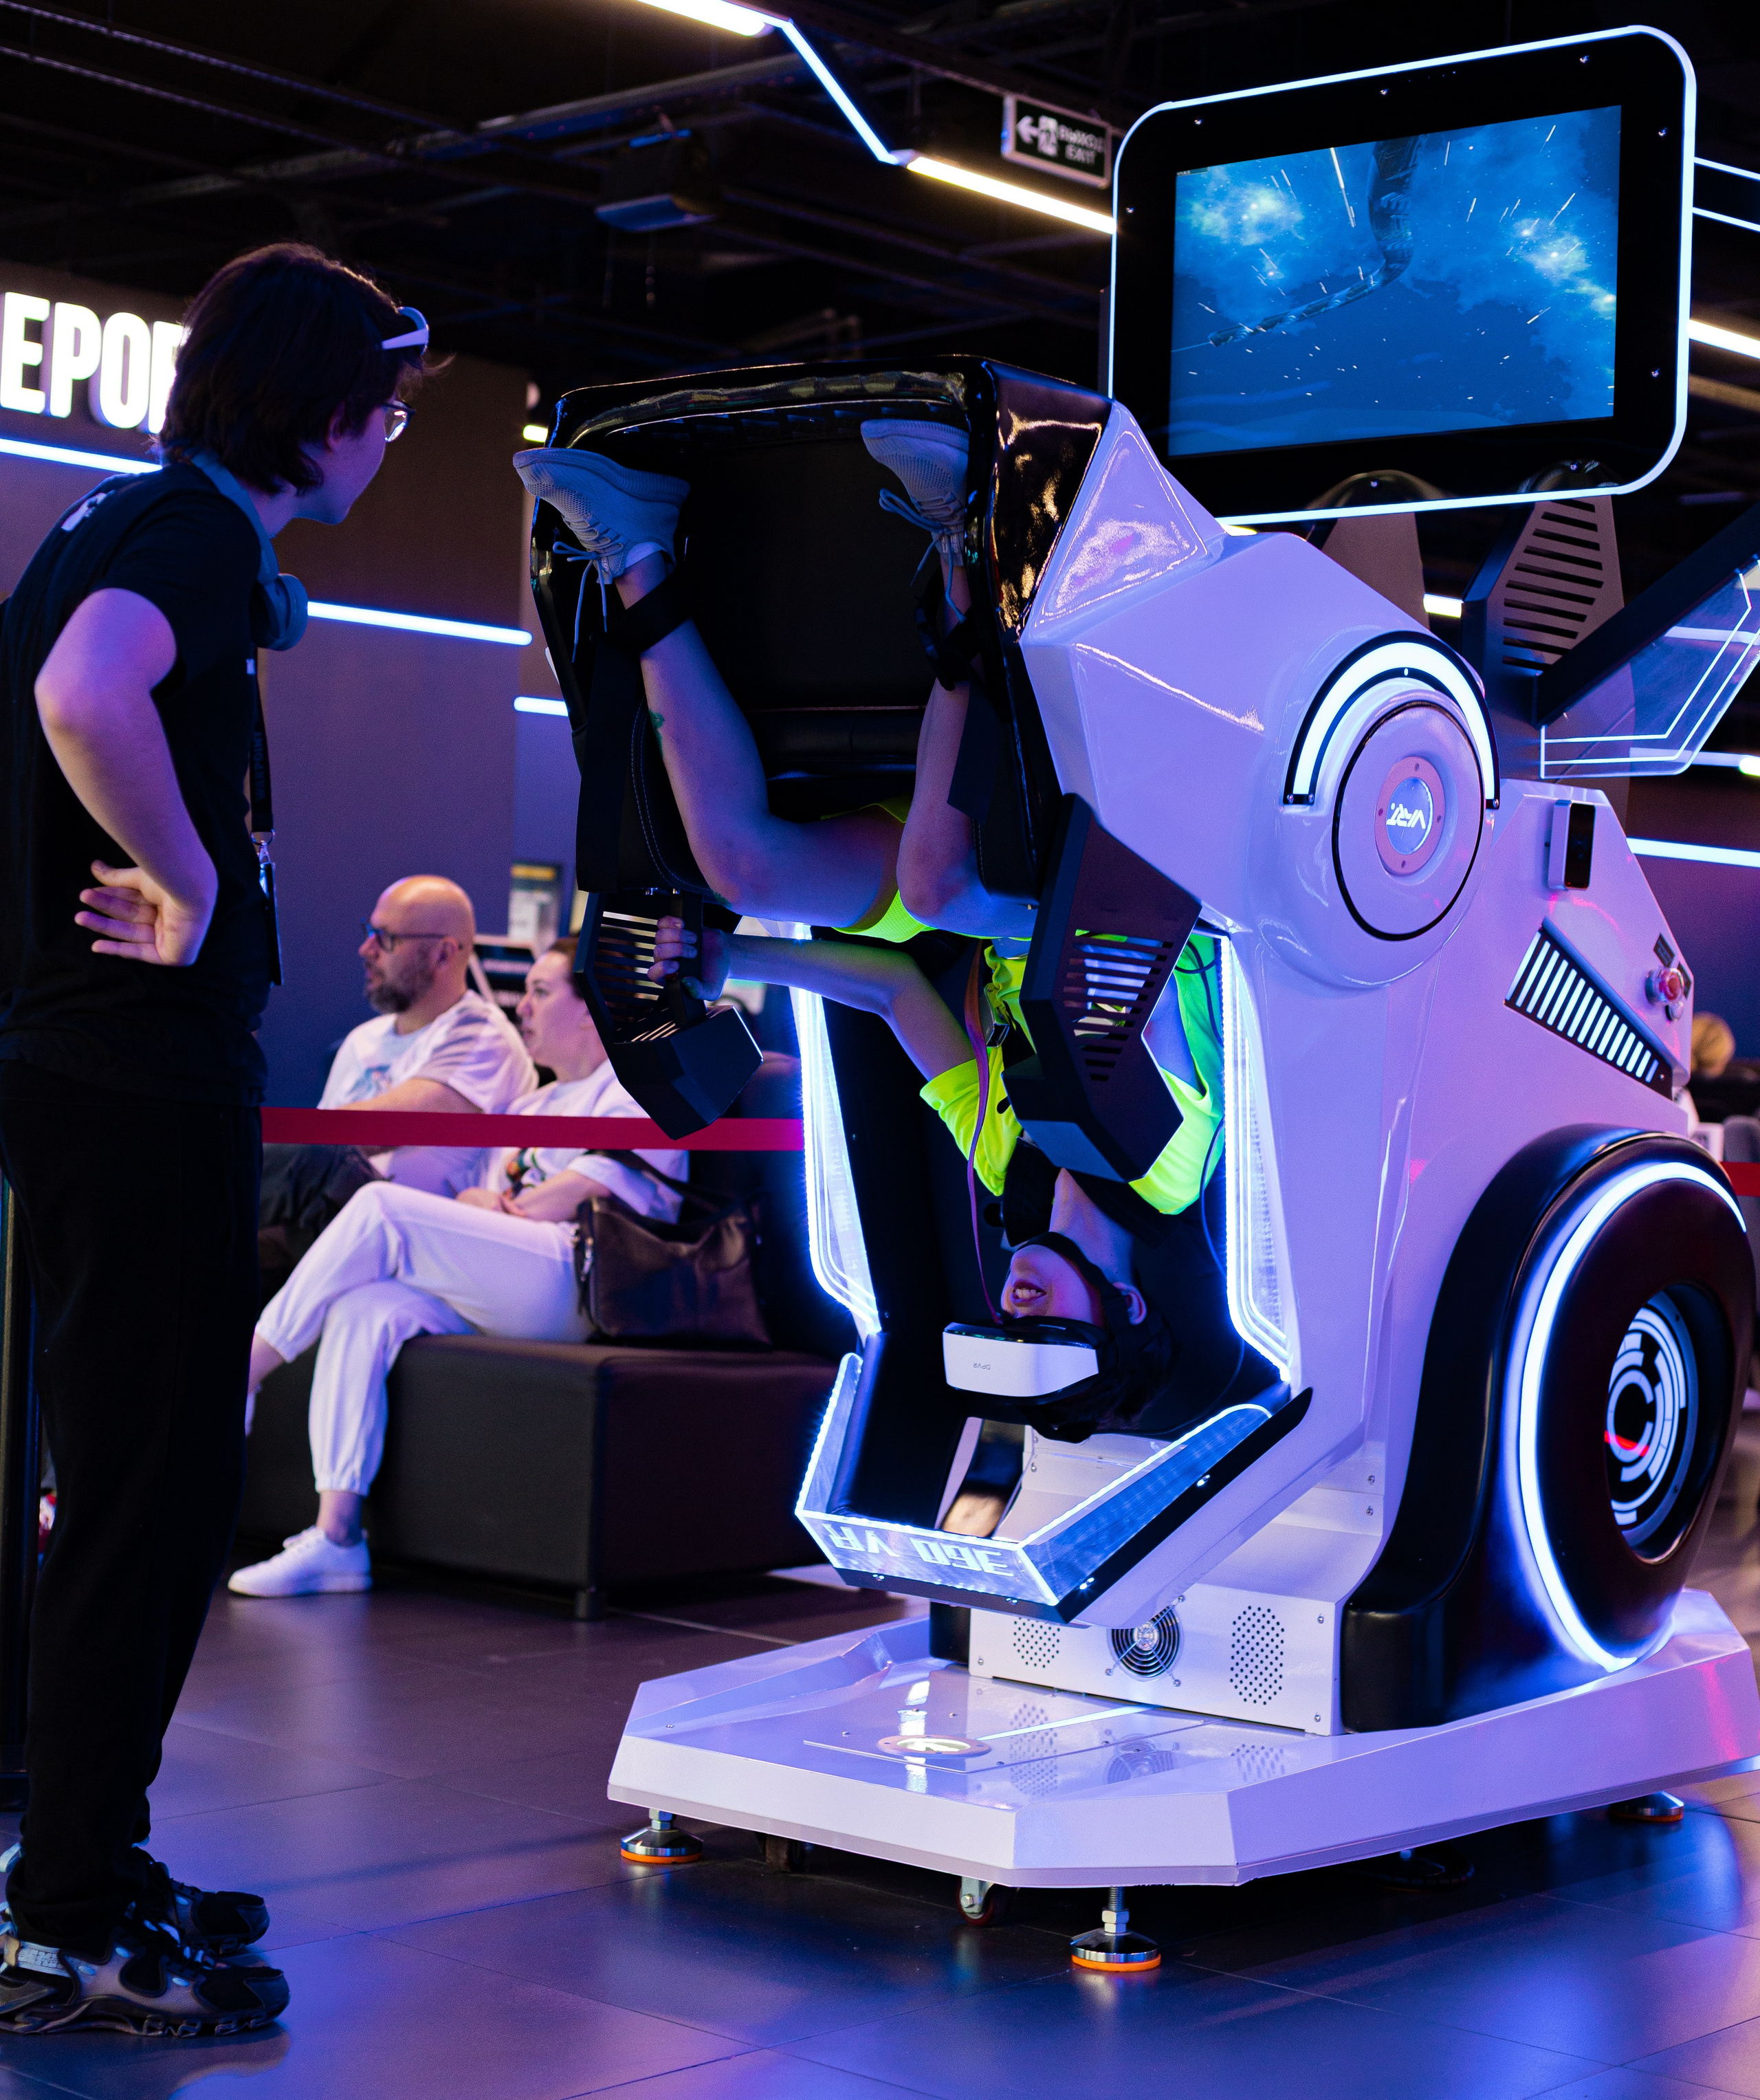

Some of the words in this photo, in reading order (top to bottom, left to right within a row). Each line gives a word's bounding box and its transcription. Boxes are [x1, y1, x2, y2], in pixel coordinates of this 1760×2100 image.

[972, 1361, 991, 1370] DPVR
[822, 1523, 900, 1557] VR
[910, 1537, 1015, 1577] 360
